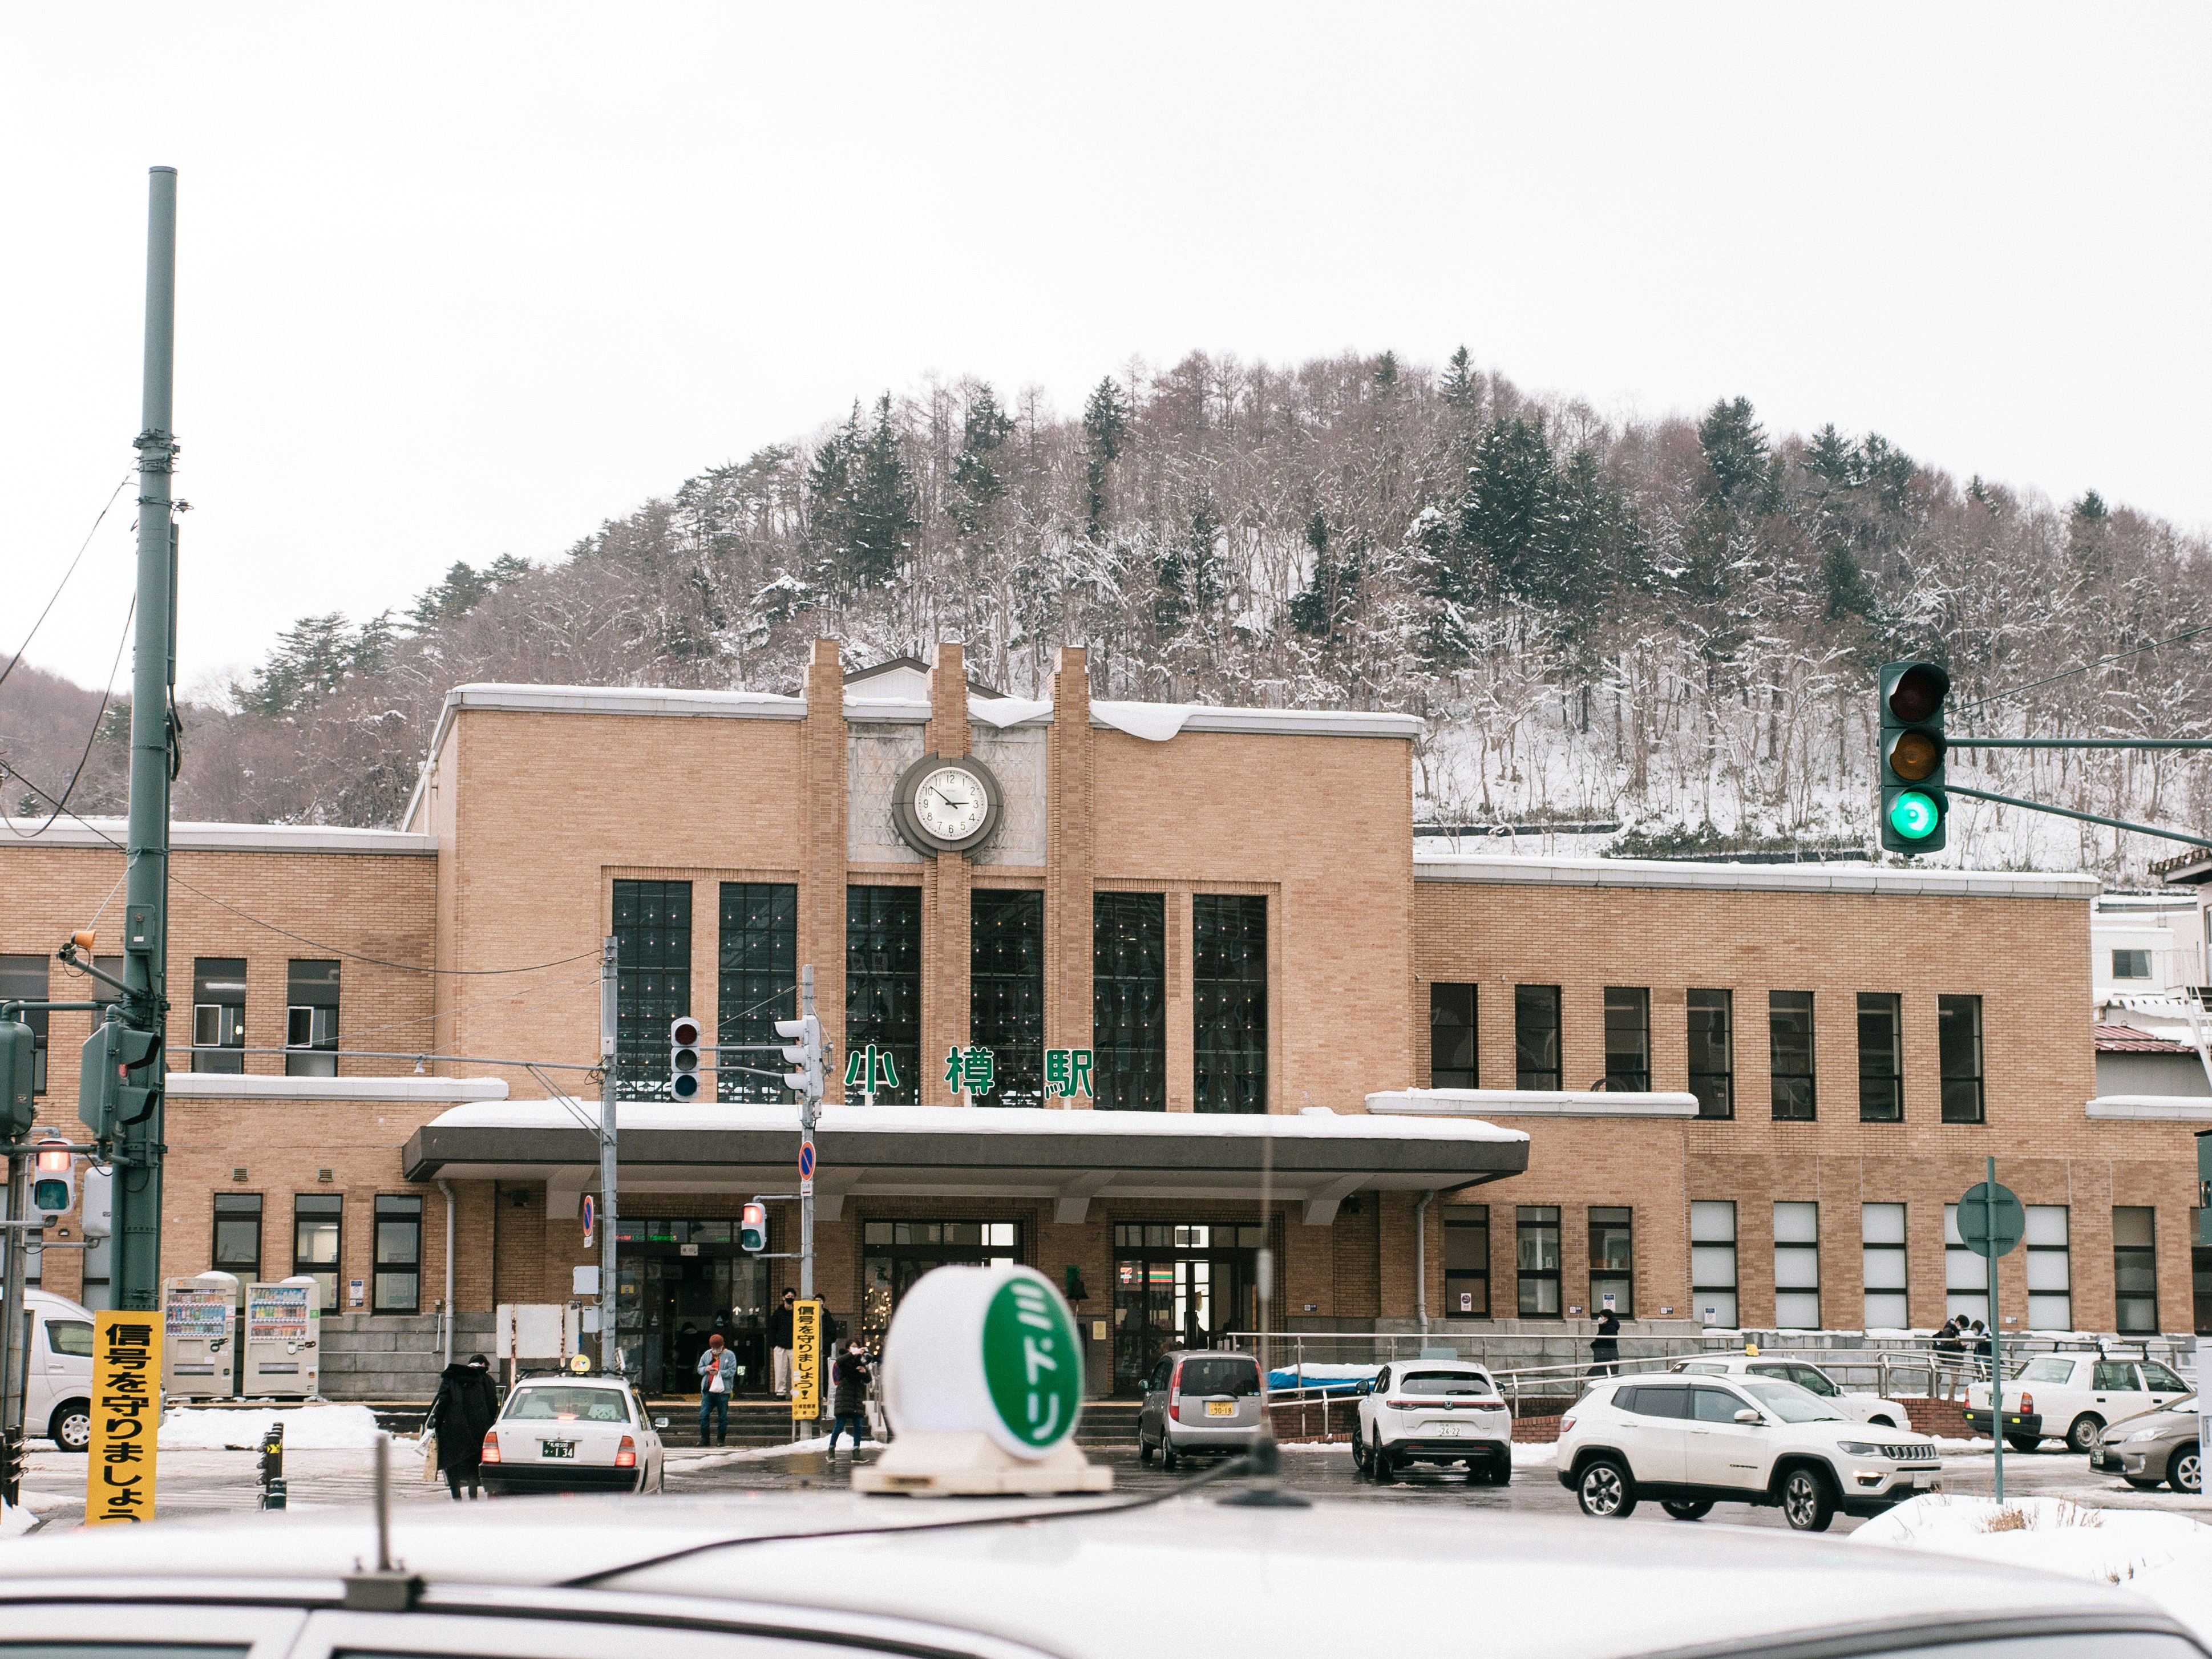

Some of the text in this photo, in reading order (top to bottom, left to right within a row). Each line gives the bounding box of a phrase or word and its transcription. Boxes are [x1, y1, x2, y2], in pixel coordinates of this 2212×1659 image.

[947, 775, 955, 783] 12
[925, 787, 932, 796] 10
[970, 787, 975, 795] 2
[924, 799, 928, 808] 9
[973, 800, 978, 808] 3
[927, 812, 932, 821] 8
[969, 813, 975, 822] 4
[937, 822, 942, 830] 7
[948, 824, 953, 833] 6
[960, 822, 965, 830] 5
[843, 1044, 1094, 1100] 小樽駅
[1010, 1283, 1060, 1441] ミドリ
[99, 1323, 153, 1525] 信号を守りましょう
